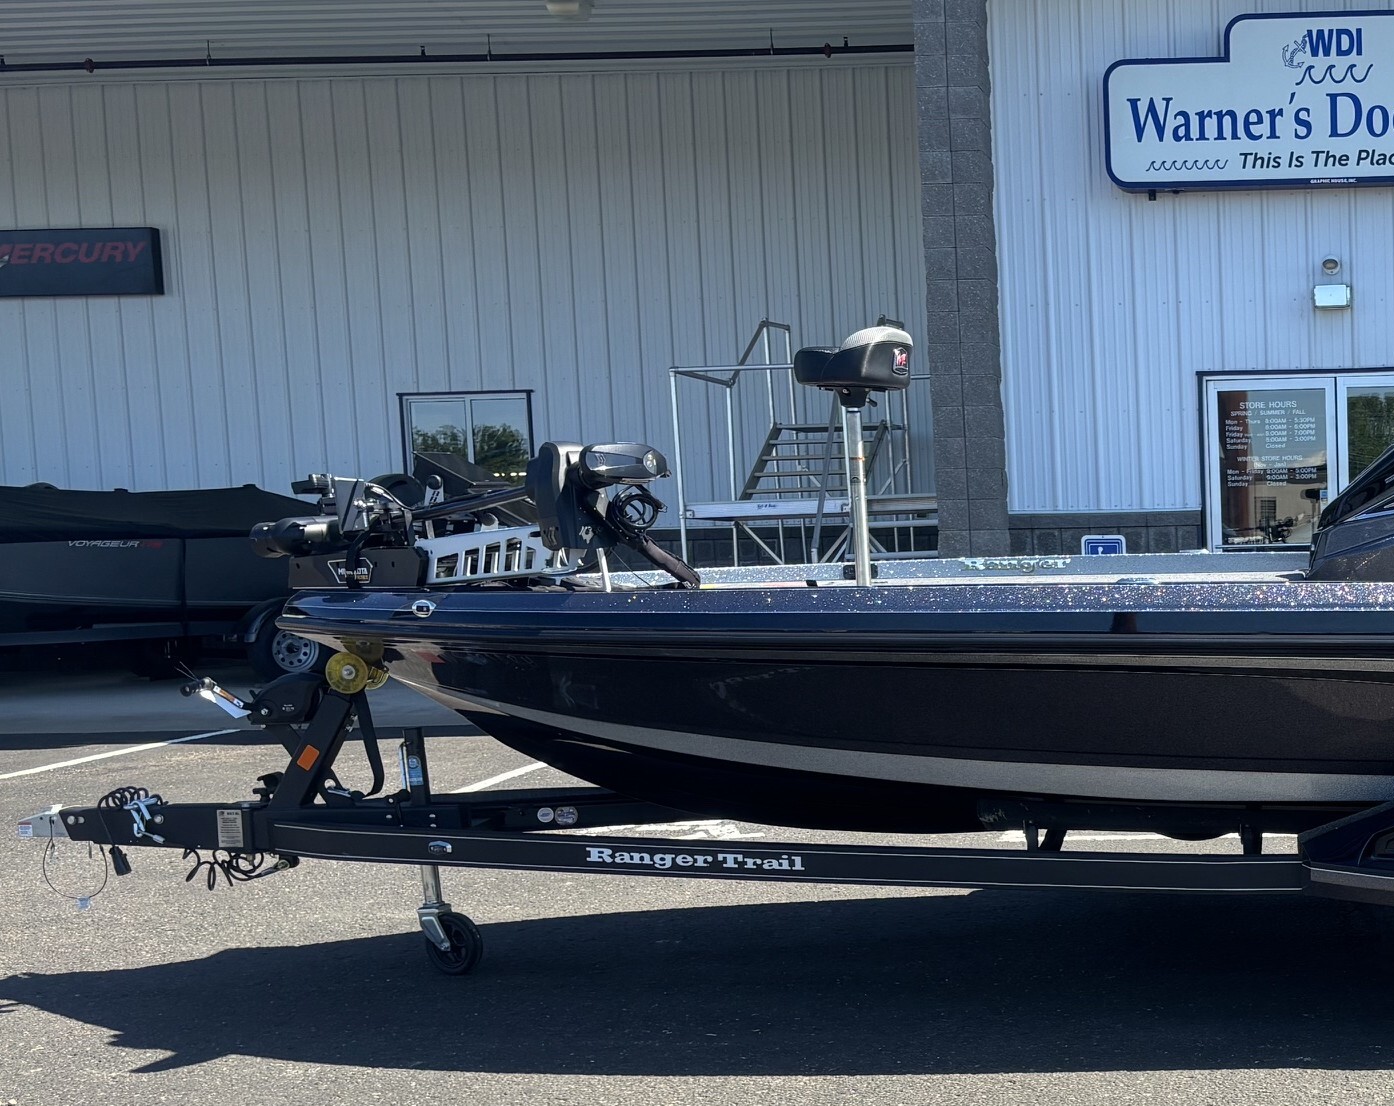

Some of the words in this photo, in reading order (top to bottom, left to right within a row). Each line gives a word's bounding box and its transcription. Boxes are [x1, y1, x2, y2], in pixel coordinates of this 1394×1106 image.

[1307, 28, 1362, 57] WDI
[1127, 92, 1312, 143] Warner's
[1239, 152, 1281, 170] This
[1287, 151, 1304, 168] Is
[1311, 150, 1350, 167] The
[1269, 401, 1297, 409] HOURS
[68, 540, 140, 548] VOYAGEUR
[960, 557, 1071, 574] Ranger
[586, 847, 714, 869] Ranger
[717, 853, 805, 872] Trail
